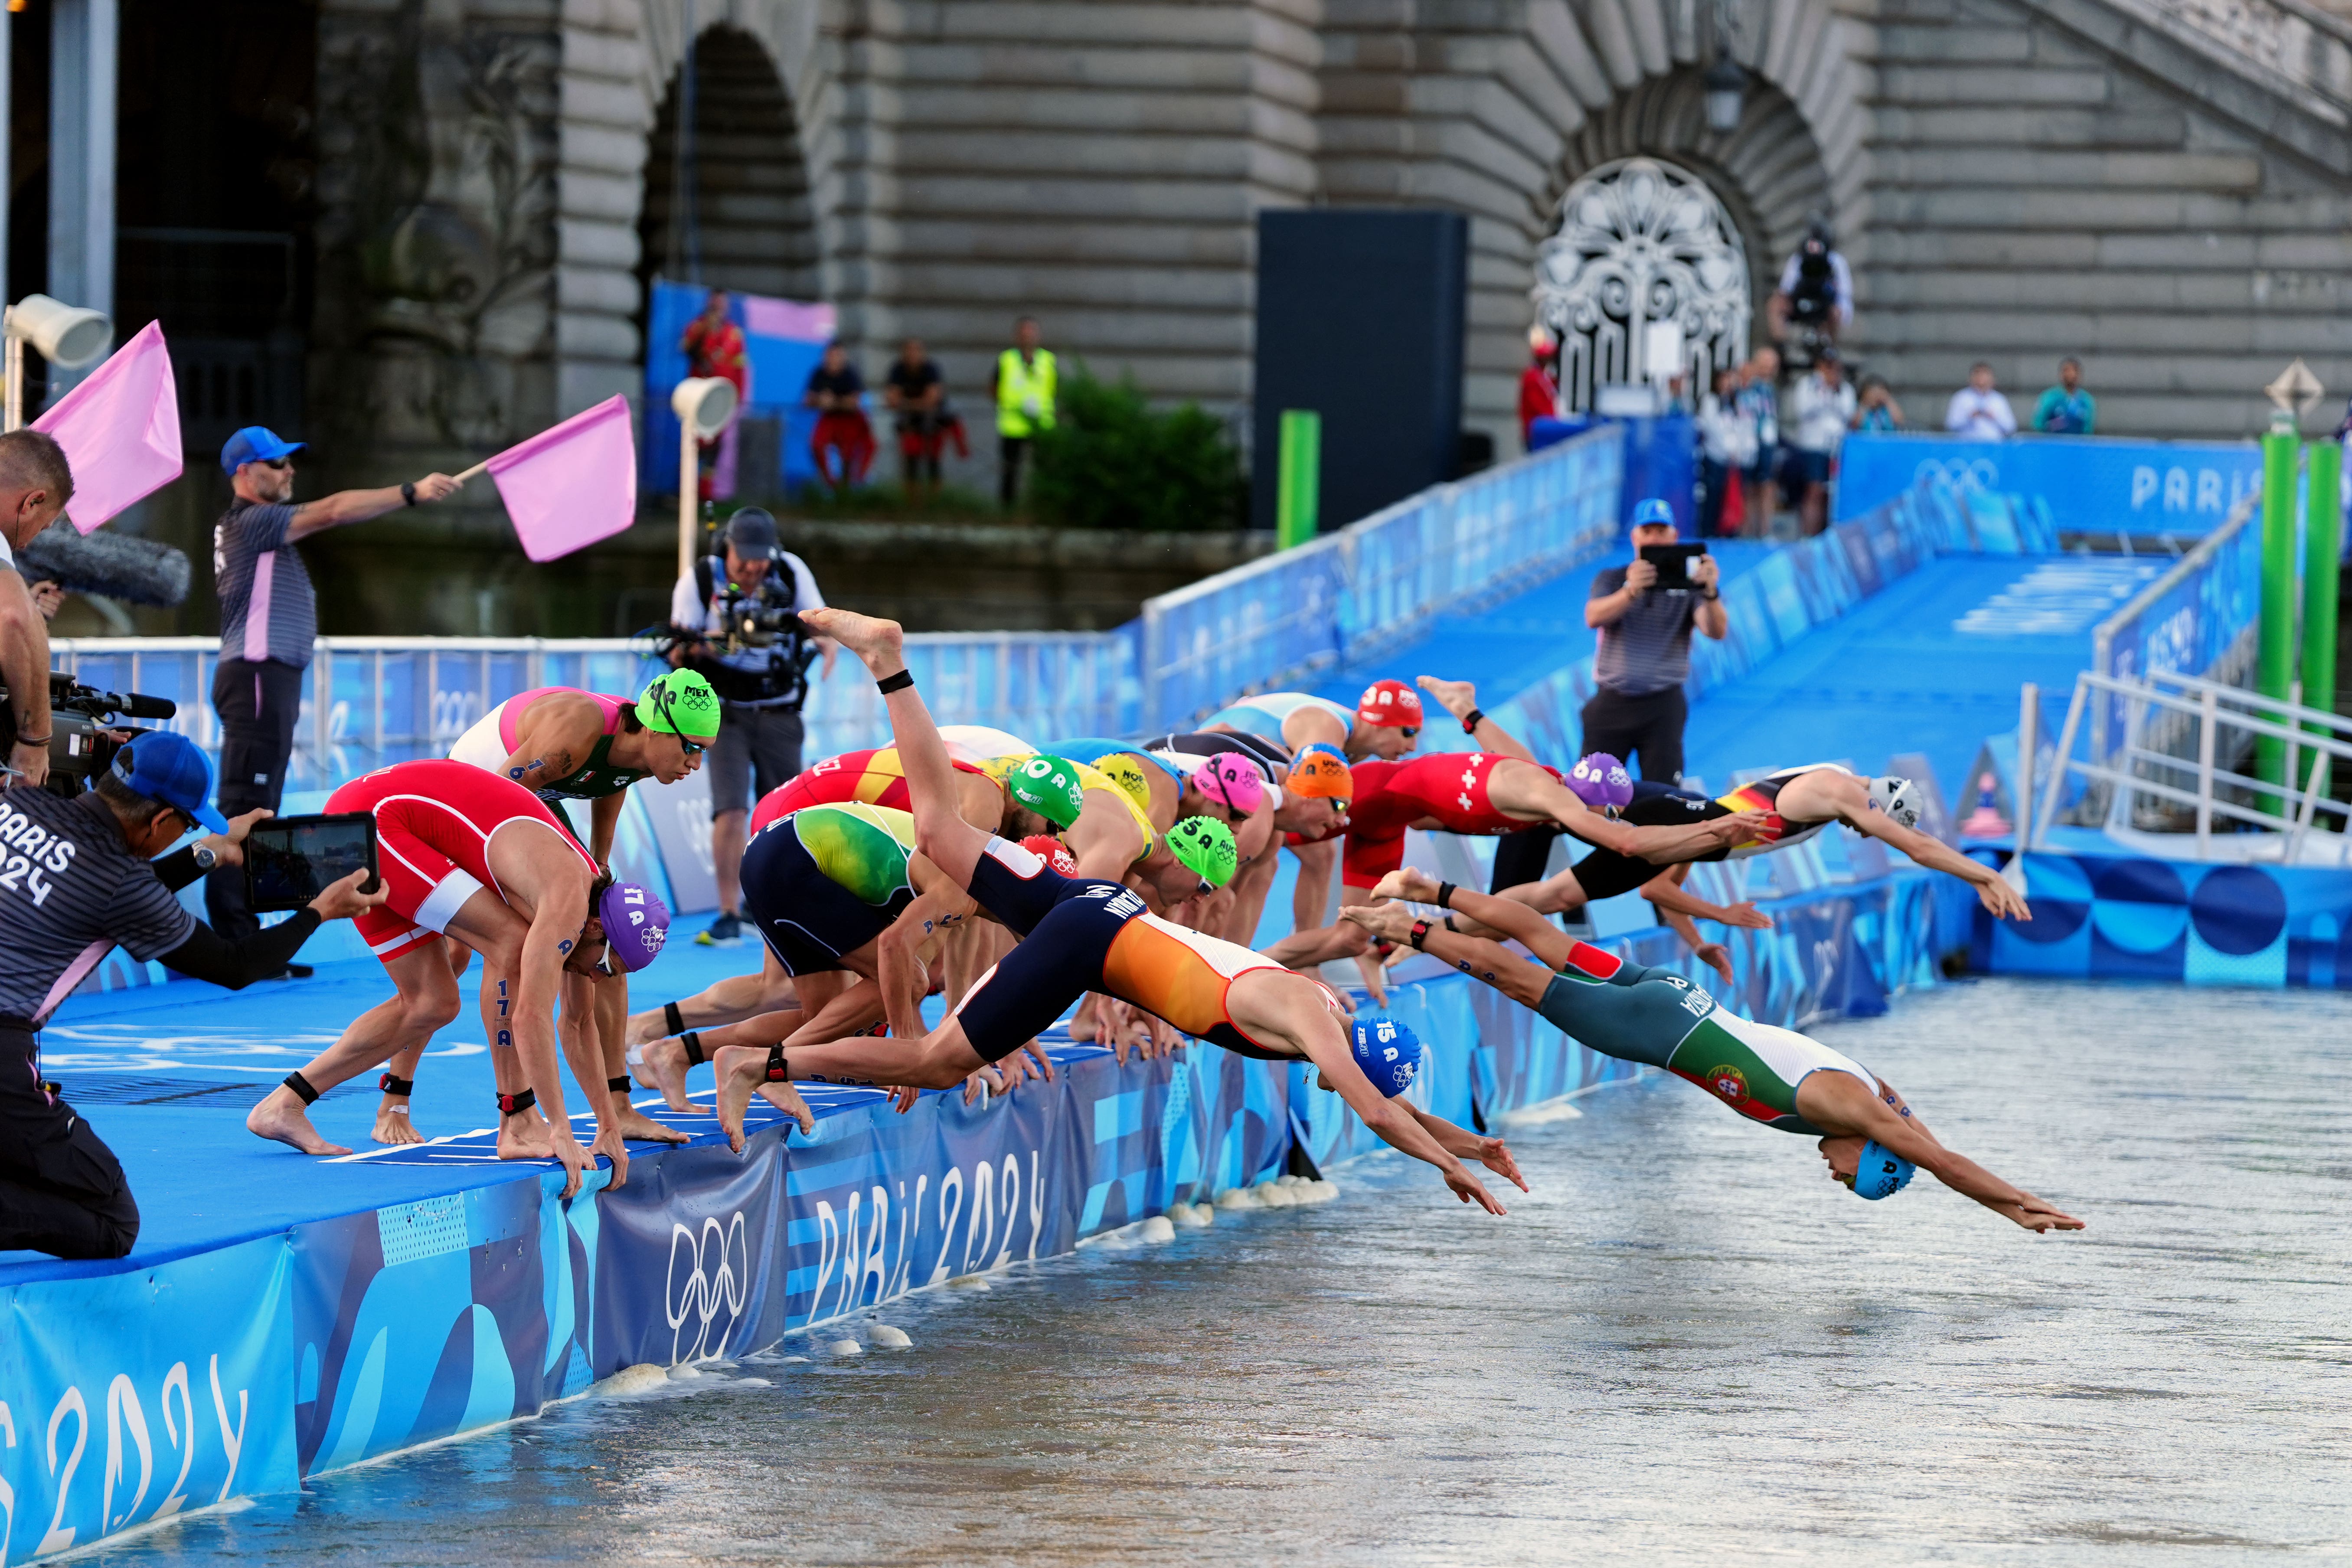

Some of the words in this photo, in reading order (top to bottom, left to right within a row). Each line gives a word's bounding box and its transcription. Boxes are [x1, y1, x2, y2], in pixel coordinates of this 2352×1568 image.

[684, 685, 710, 697] MEX
[1361, 686, 1378, 706] 3
[1378, 690, 1393, 706] A
[508, 758, 546, 781] 16
[1019, 758, 1053, 779] 10
[1050, 773, 1066, 789] A
[1224, 768, 1237, 782] A
[1305, 763, 1316, 775] A
[1573, 759, 1590, 780] 6
[1588, 768, 1603, 784] A
[1183, 819, 1203, 836] 5
[1197, 834, 1213, 849] A
[1219, 840, 1235, 855] AUS
[624, 888, 645, 905] 17
[628, 910, 645, 926] A
[557, 938, 573, 957] A
[496, 1029, 512, 1047] A
[1376, 1021, 1397, 1043] 15
[1383, 1046, 1399, 1062] A
[1882, 1160, 1898, 1174] A
[927, 1150, 1045, 1285] 2024
[33, 1353, 248, 1557] 2024
